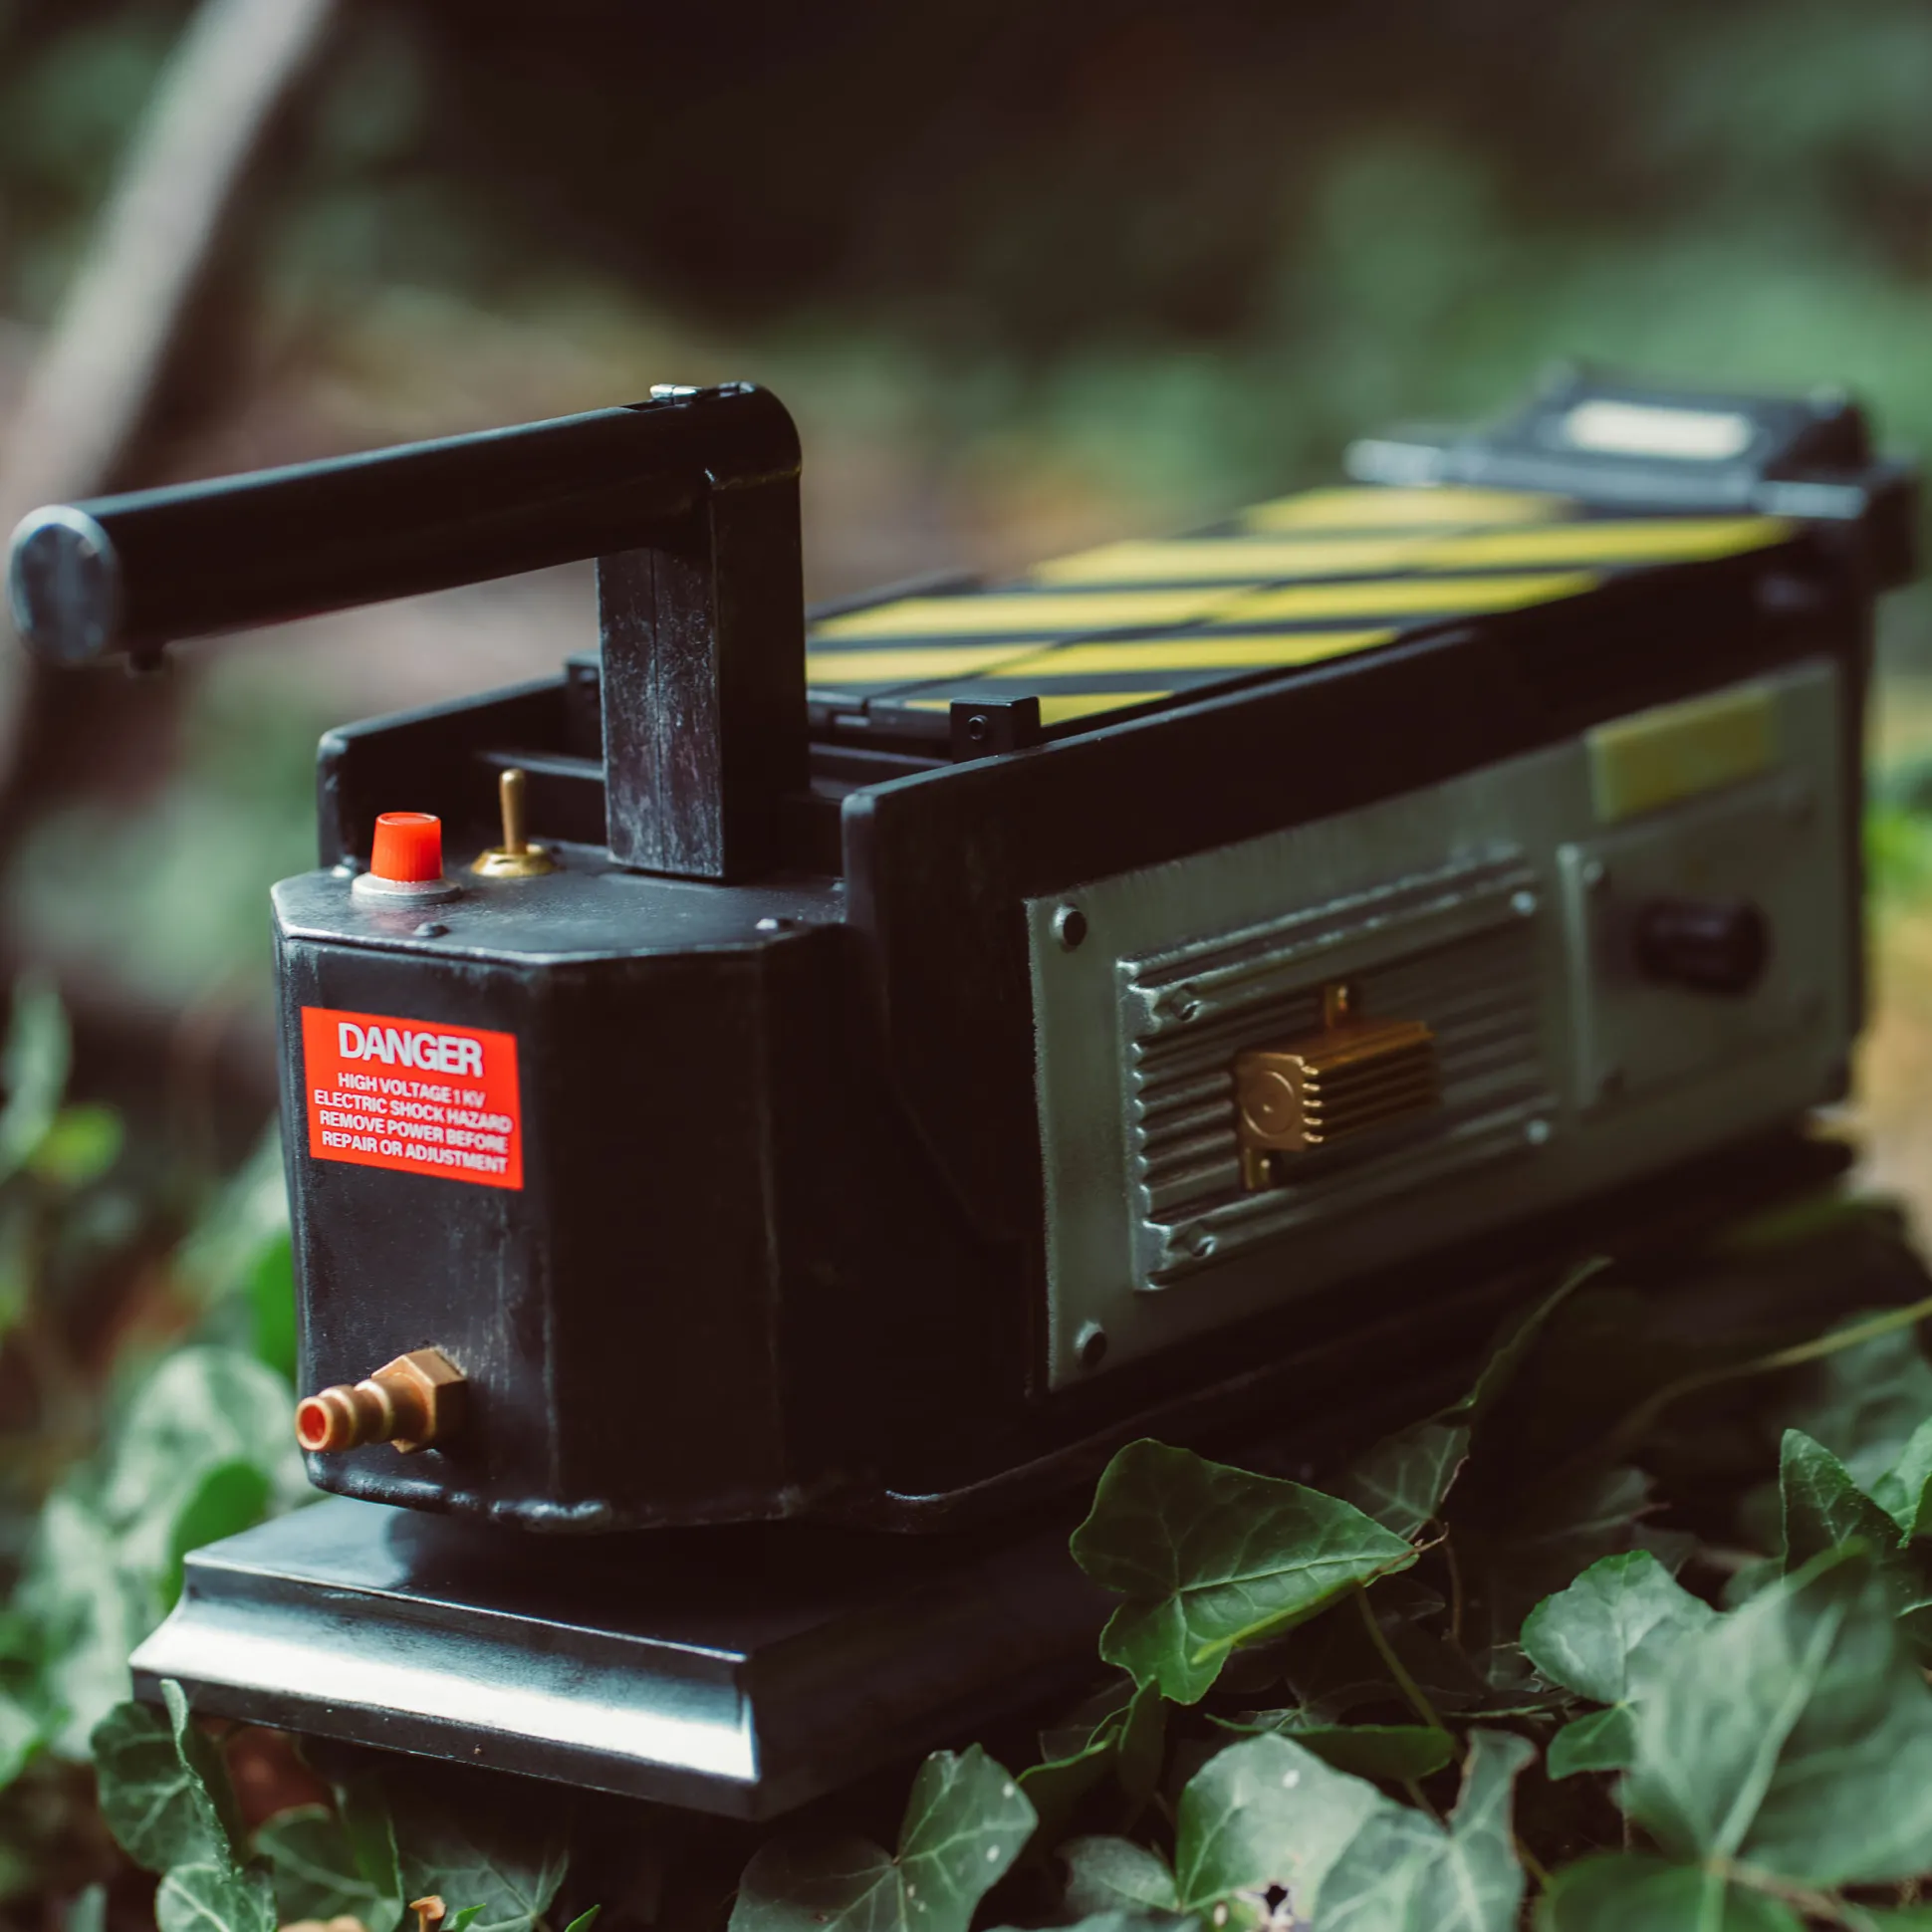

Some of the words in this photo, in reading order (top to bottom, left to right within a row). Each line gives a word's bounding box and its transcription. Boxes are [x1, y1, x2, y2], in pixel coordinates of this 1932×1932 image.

[338, 1022, 483, 1079] DANGER
[314, 1089, 387, 1113] ELECTRIC
[389, 1099, 444, 1122] SHOCK
[446, 1108, 513, 1133] HAZARD
[338, 1072, 377, 1092] HIGH
[379, 1078, 452, 1102] VOLTAGE
[454, 1089, 460, 1105] 1
[461, 1089, 486, 1108] KV
[320, 1110, 385, 1134] REMOVE
[387, 1119, 444, 1143] POWER
[446, 1128, 508, 1153] BEFORE
[322, 1131, 377, 1152] REPAIR
[379, 1139, 402, 1156] OR
[405, 1143, 508, 1174] ADJUSTMENT
